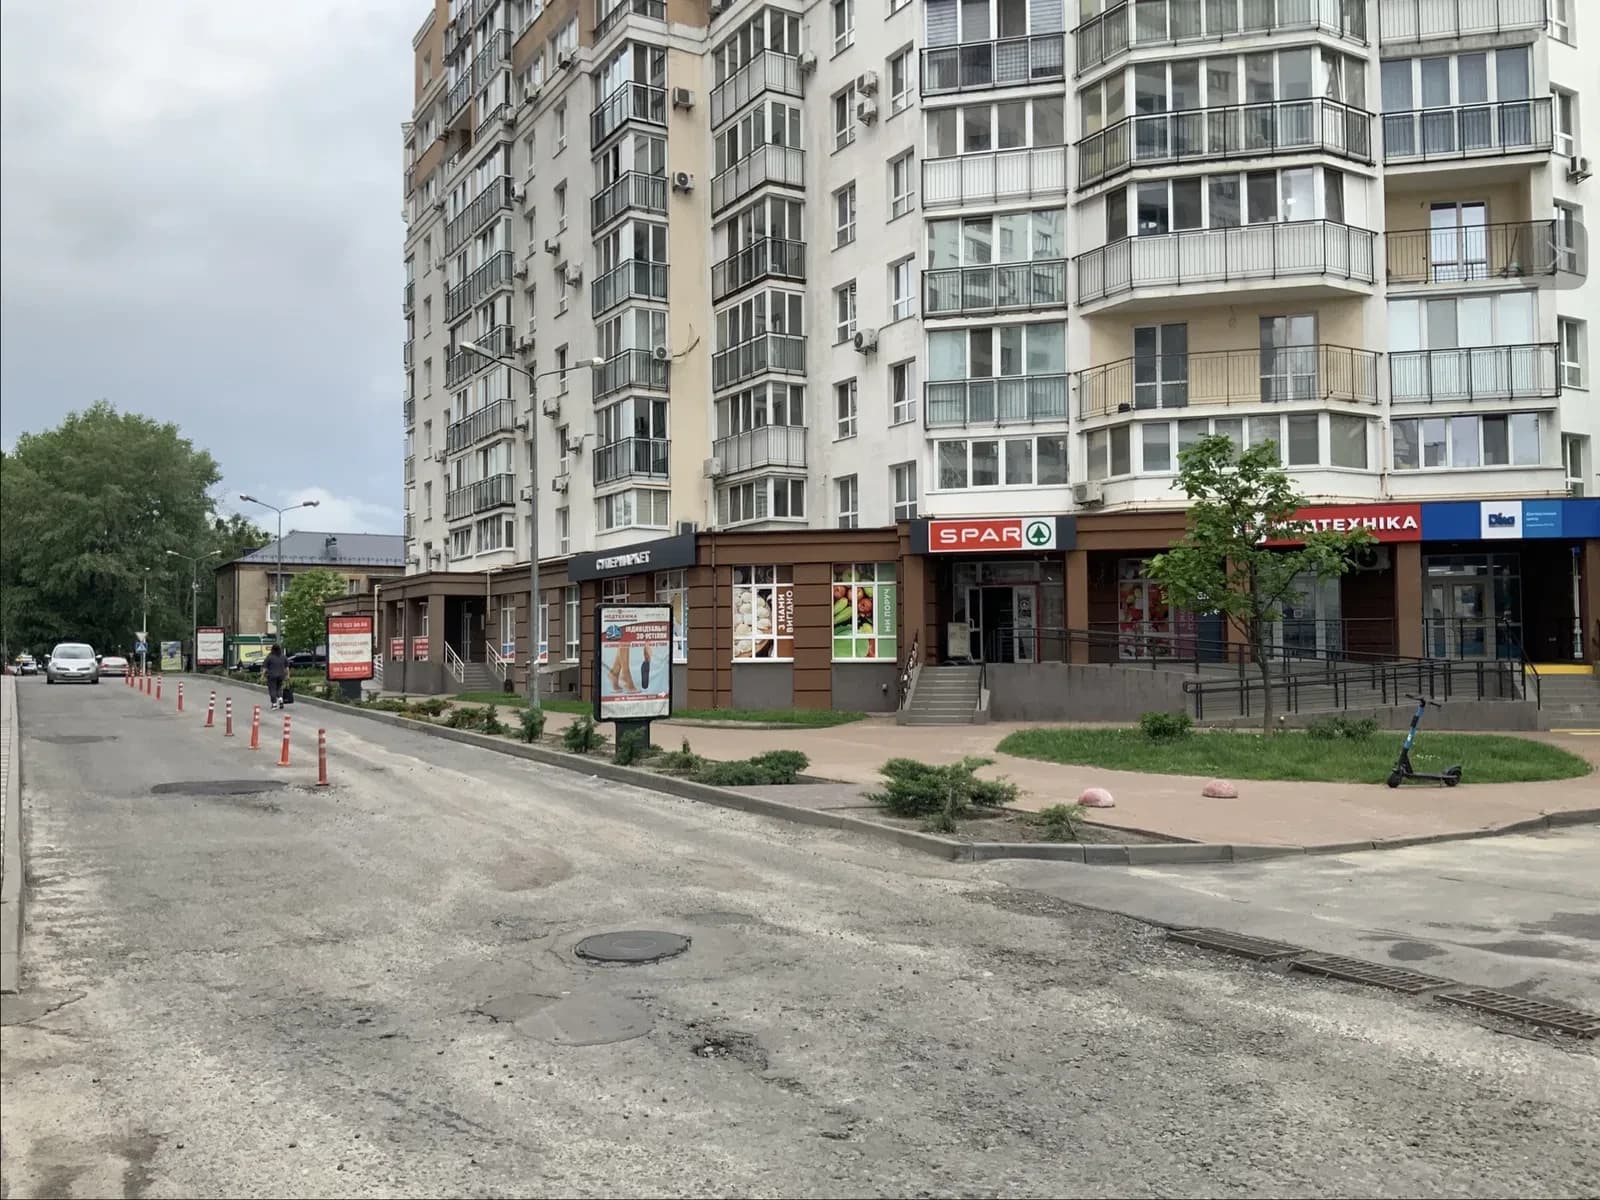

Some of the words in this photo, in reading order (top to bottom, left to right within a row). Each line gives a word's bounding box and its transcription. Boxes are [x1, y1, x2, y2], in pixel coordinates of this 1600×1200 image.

[939, 527, 1021, 544] SPAR
[595, 550, 652, 571] СУПЕРМАРКЕТ
[777, 593, 786, 623] НАМИ
